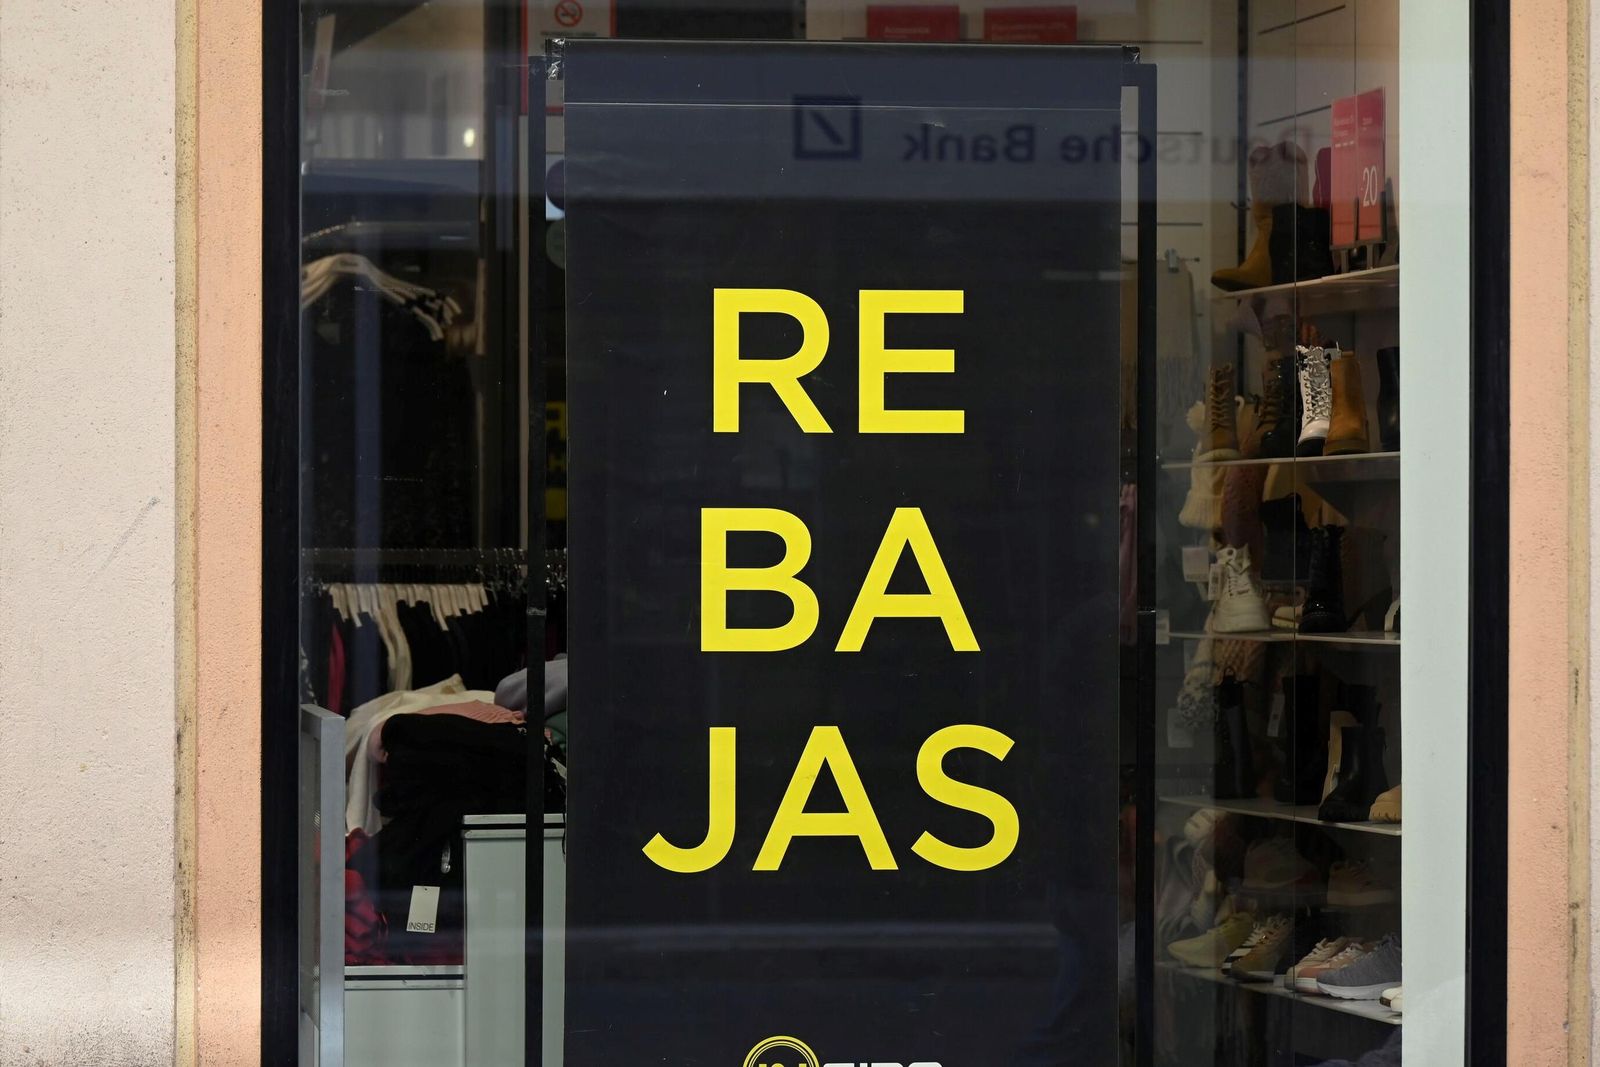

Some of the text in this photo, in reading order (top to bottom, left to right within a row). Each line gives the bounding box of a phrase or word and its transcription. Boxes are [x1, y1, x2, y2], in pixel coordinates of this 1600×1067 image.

[713, 287, 965, 434] RE
[700, 507, 980, 653] BA
[642, 724, 1020, 873] JAS
[409, 921, 435, 931] INSIDE
